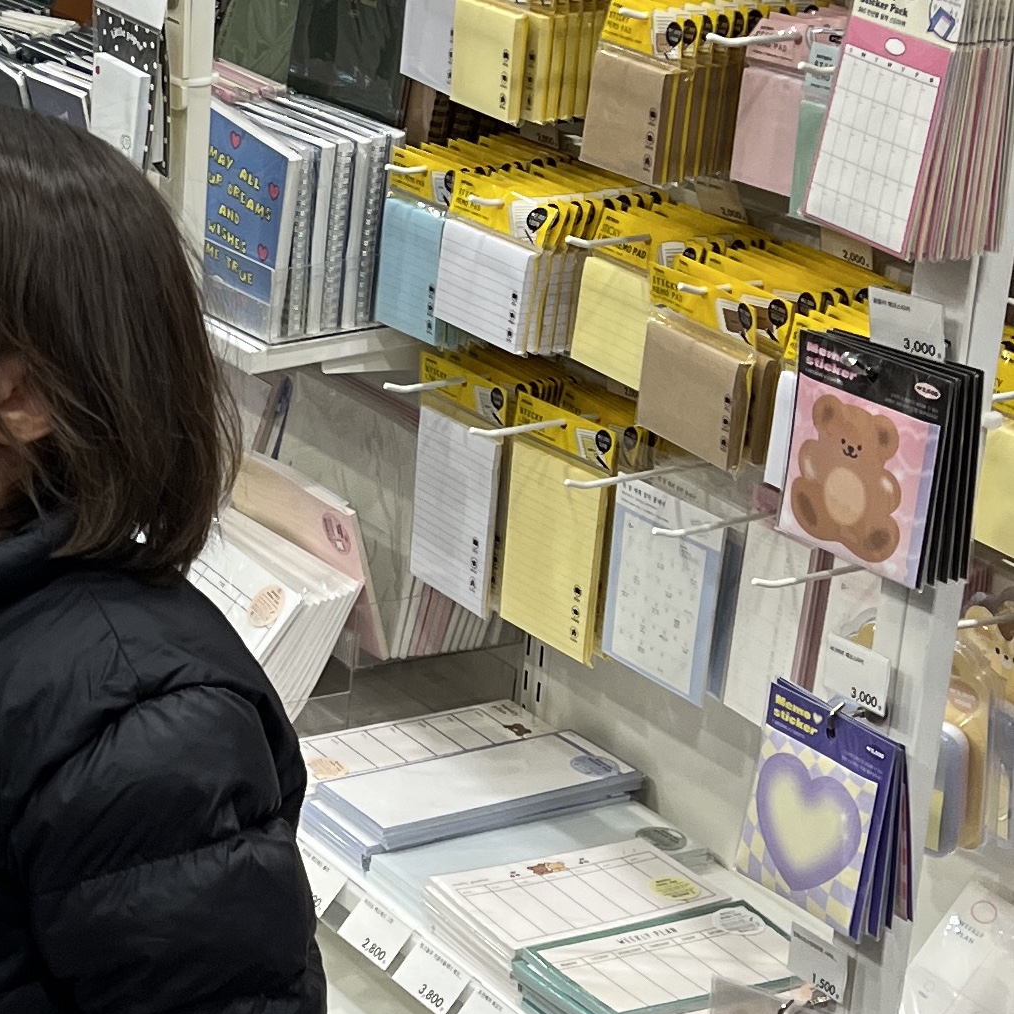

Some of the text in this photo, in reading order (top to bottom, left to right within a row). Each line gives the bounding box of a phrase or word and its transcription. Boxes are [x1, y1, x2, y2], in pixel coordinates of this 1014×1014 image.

[890, 4, 908, 17] Pack
[208, 145, 261, 190] MAY ALL
[227, 183, 272, 221] DREAMS
[218, 204, 240, 225] AND
[207, 219, 247, 254] WISHES
[632, 246, 647, 259] PAD
[842, 249, 866, 265] 2,000
[225, 253, 254, 285] TRUE
[806, 341, 843, 363] Mem
[903, 337, 936, 357] 3,000
[774, 693, 812, 720] Memo
[850, 686, 878, 708] 3,000
[772, 707, 819, 736] sticker
[615, 932, 651, 945] WEEKLY
[652, 927, 678, 938] PLAN
[361, 937, 387, 961] 2,800
[418, 983, 445, 1008] 3,800
[812, 973, 836, 996] 1,500
